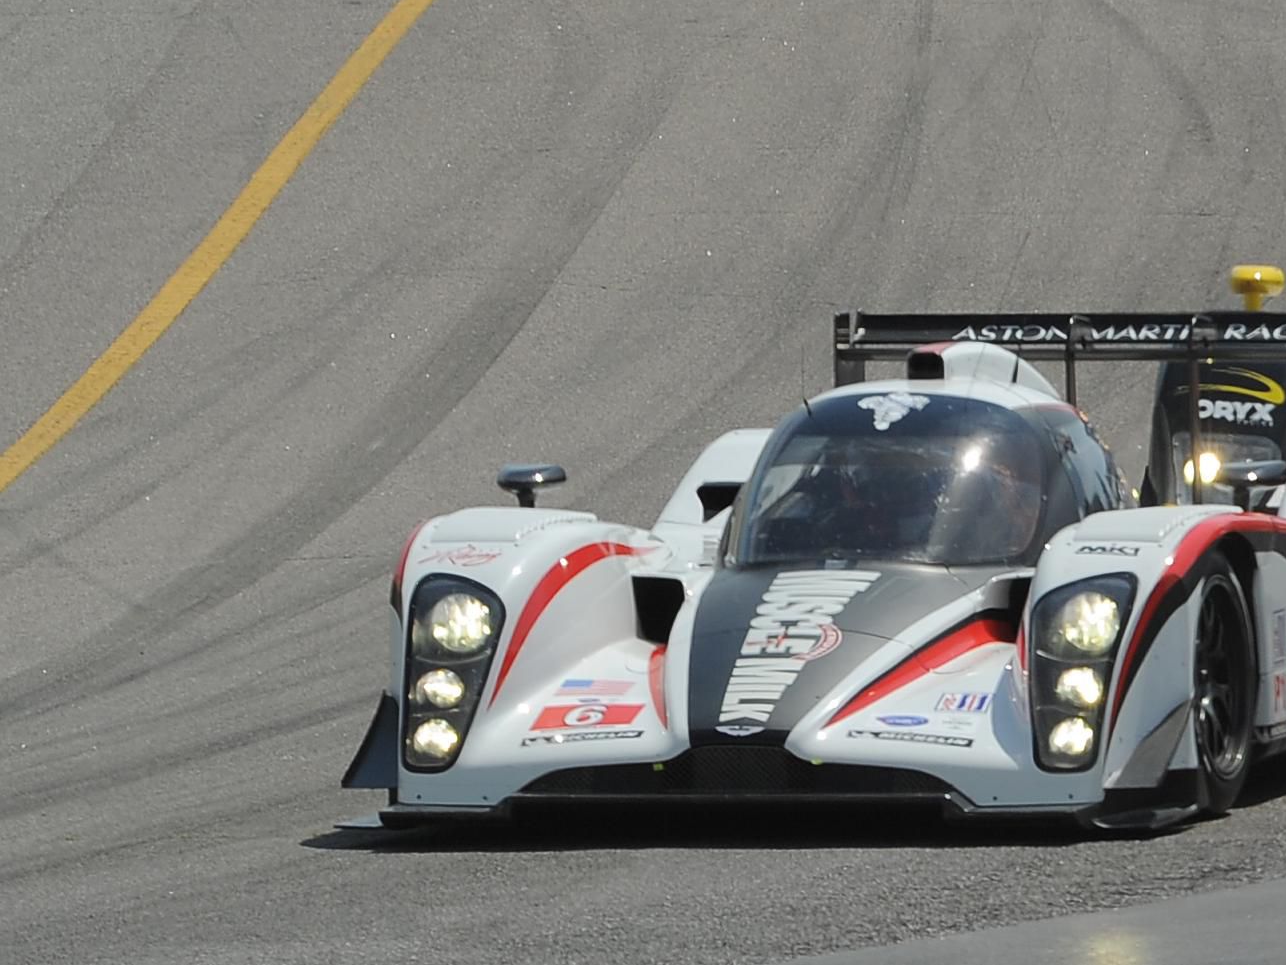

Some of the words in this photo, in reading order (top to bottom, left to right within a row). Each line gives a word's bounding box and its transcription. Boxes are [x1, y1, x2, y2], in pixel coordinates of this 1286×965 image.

[951, 324, 1066, 340] ASTON
[740, 569, 882, 657] MUSCLE
[718, 657, 807, 723] MILK
[563, 702, 608, 727] 6
